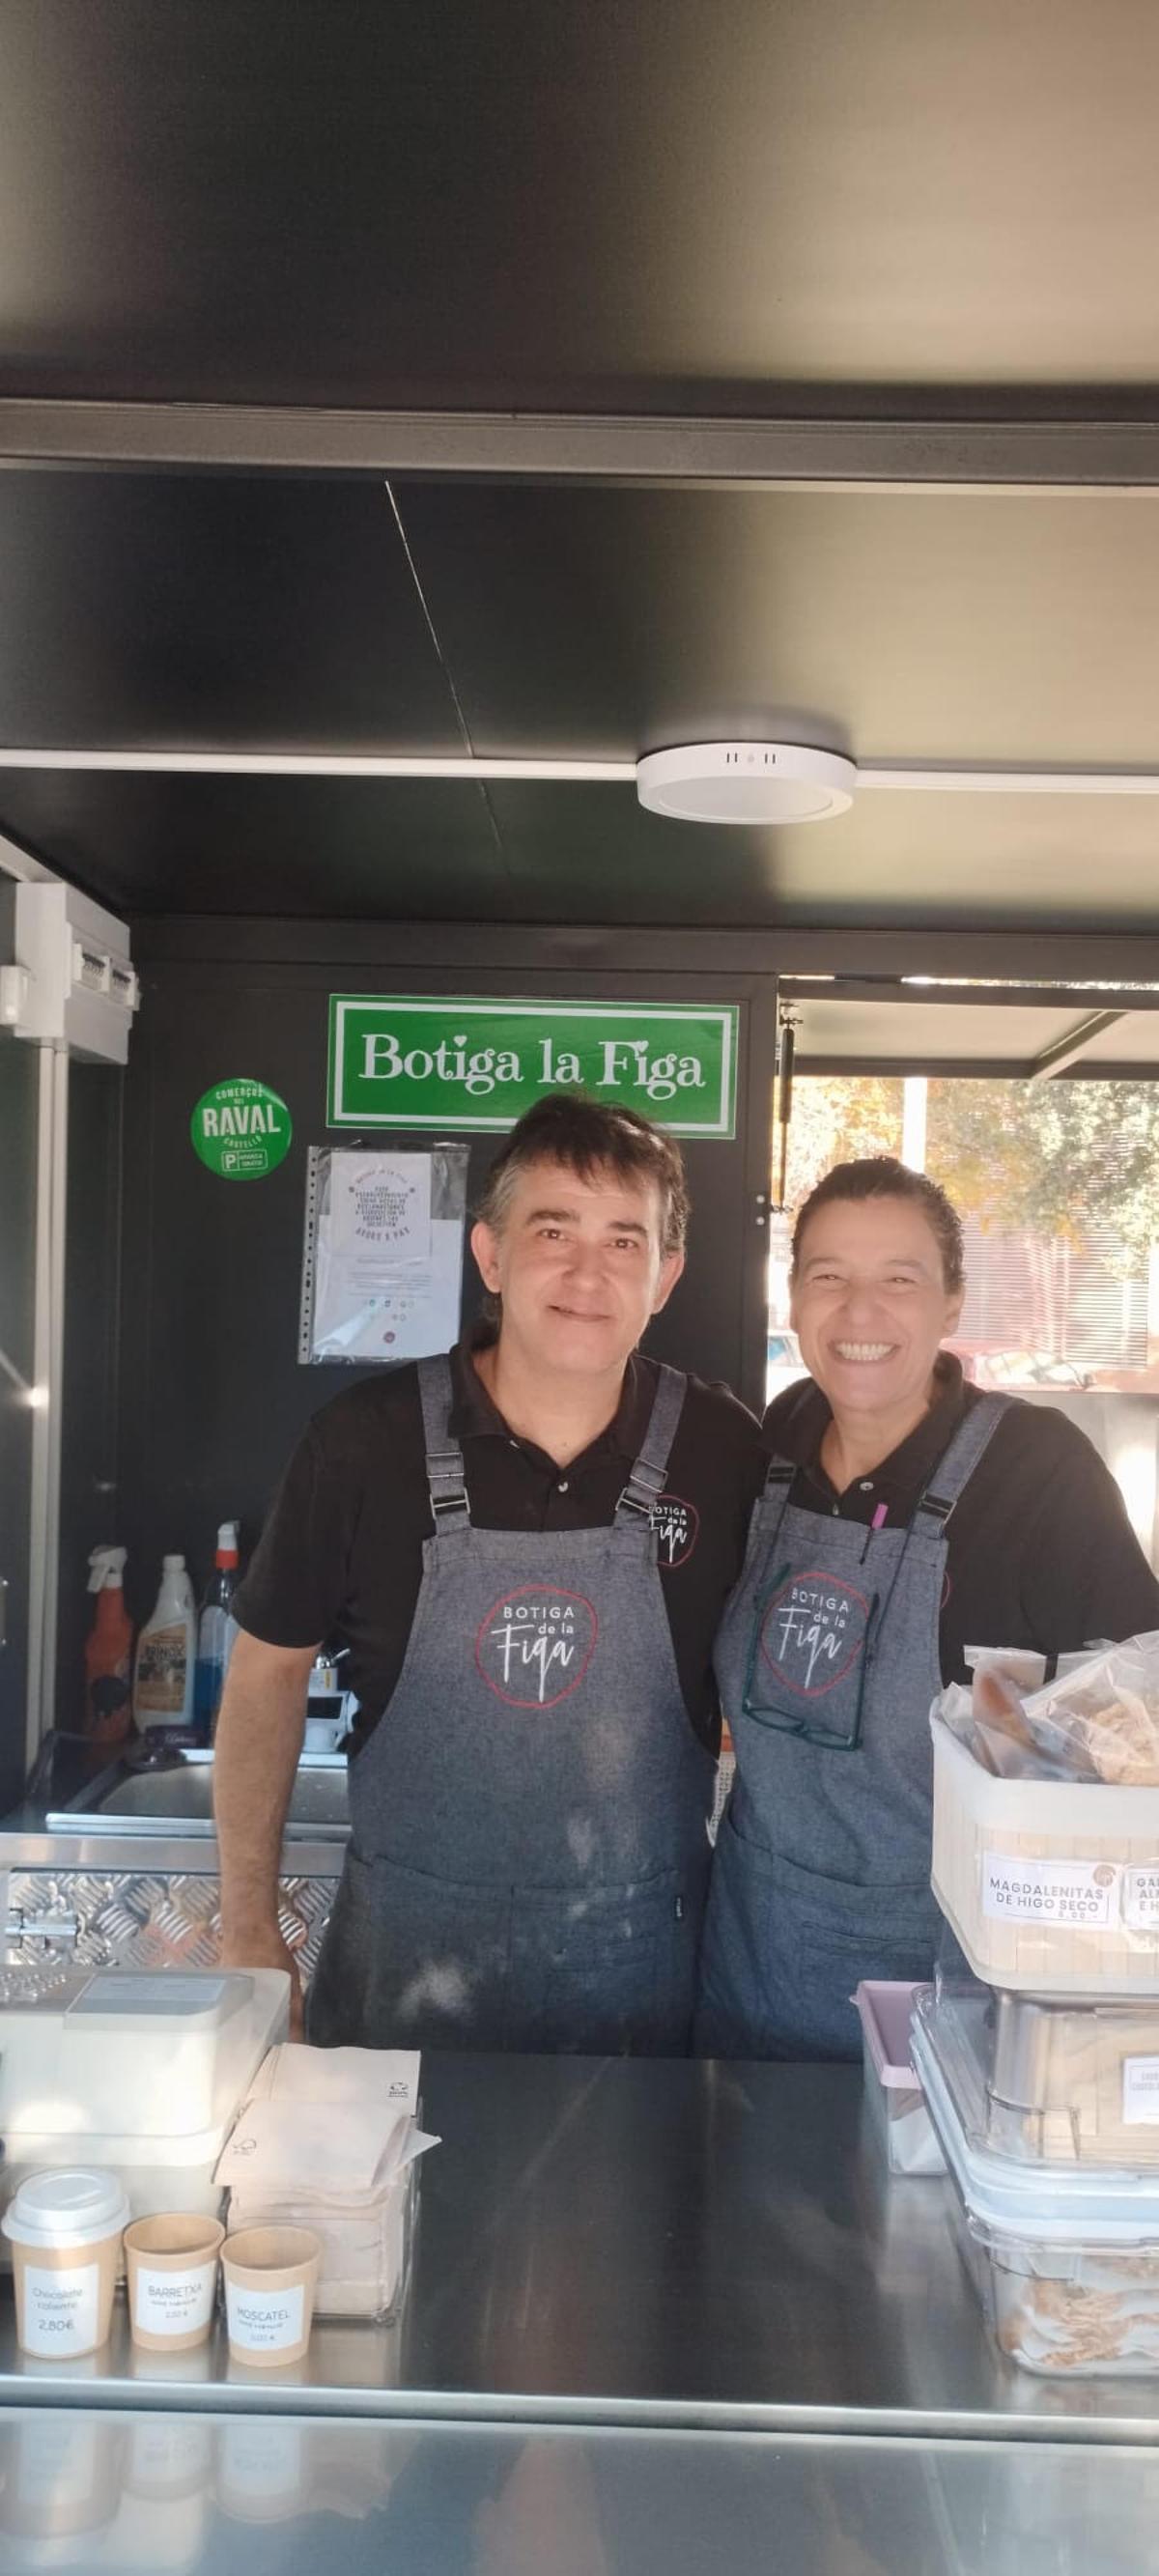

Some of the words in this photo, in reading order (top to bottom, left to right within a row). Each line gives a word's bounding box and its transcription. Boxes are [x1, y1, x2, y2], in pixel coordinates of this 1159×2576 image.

[358, 1033, 524, 1095] Botiga
[536, 1038, 584, 1084] la
[596, 1040, 706, 1101] Figa
[202, 1104, 281, 1137] RAVAL
[224, 1154, 237, 1169] P
[792, 1588, 849, 1614] BOTIGA
[503, 1606, 575, 1620] BOTIGA
[813, 1612, 830, 1625] de
[834, 1615, 846, 1628] la
[538, 1623, 556, 1634] de
[561, 1623, 574, 1634] la
[777, 1604, 843, 1690] Figa
[491, 1624, 575, 1703] Figa
[990, 1877, 1104, 1900] MAGDALENITAS
[996, 1892, 1012, 1905] DE
[1017, 1896, 1056, 1910] HIGO
[1059, 1899, 1099, 1912] SECO
[1140, 1900, 1146, 1911] E
[238, 2307, 291, 2322] MOSCATEL
